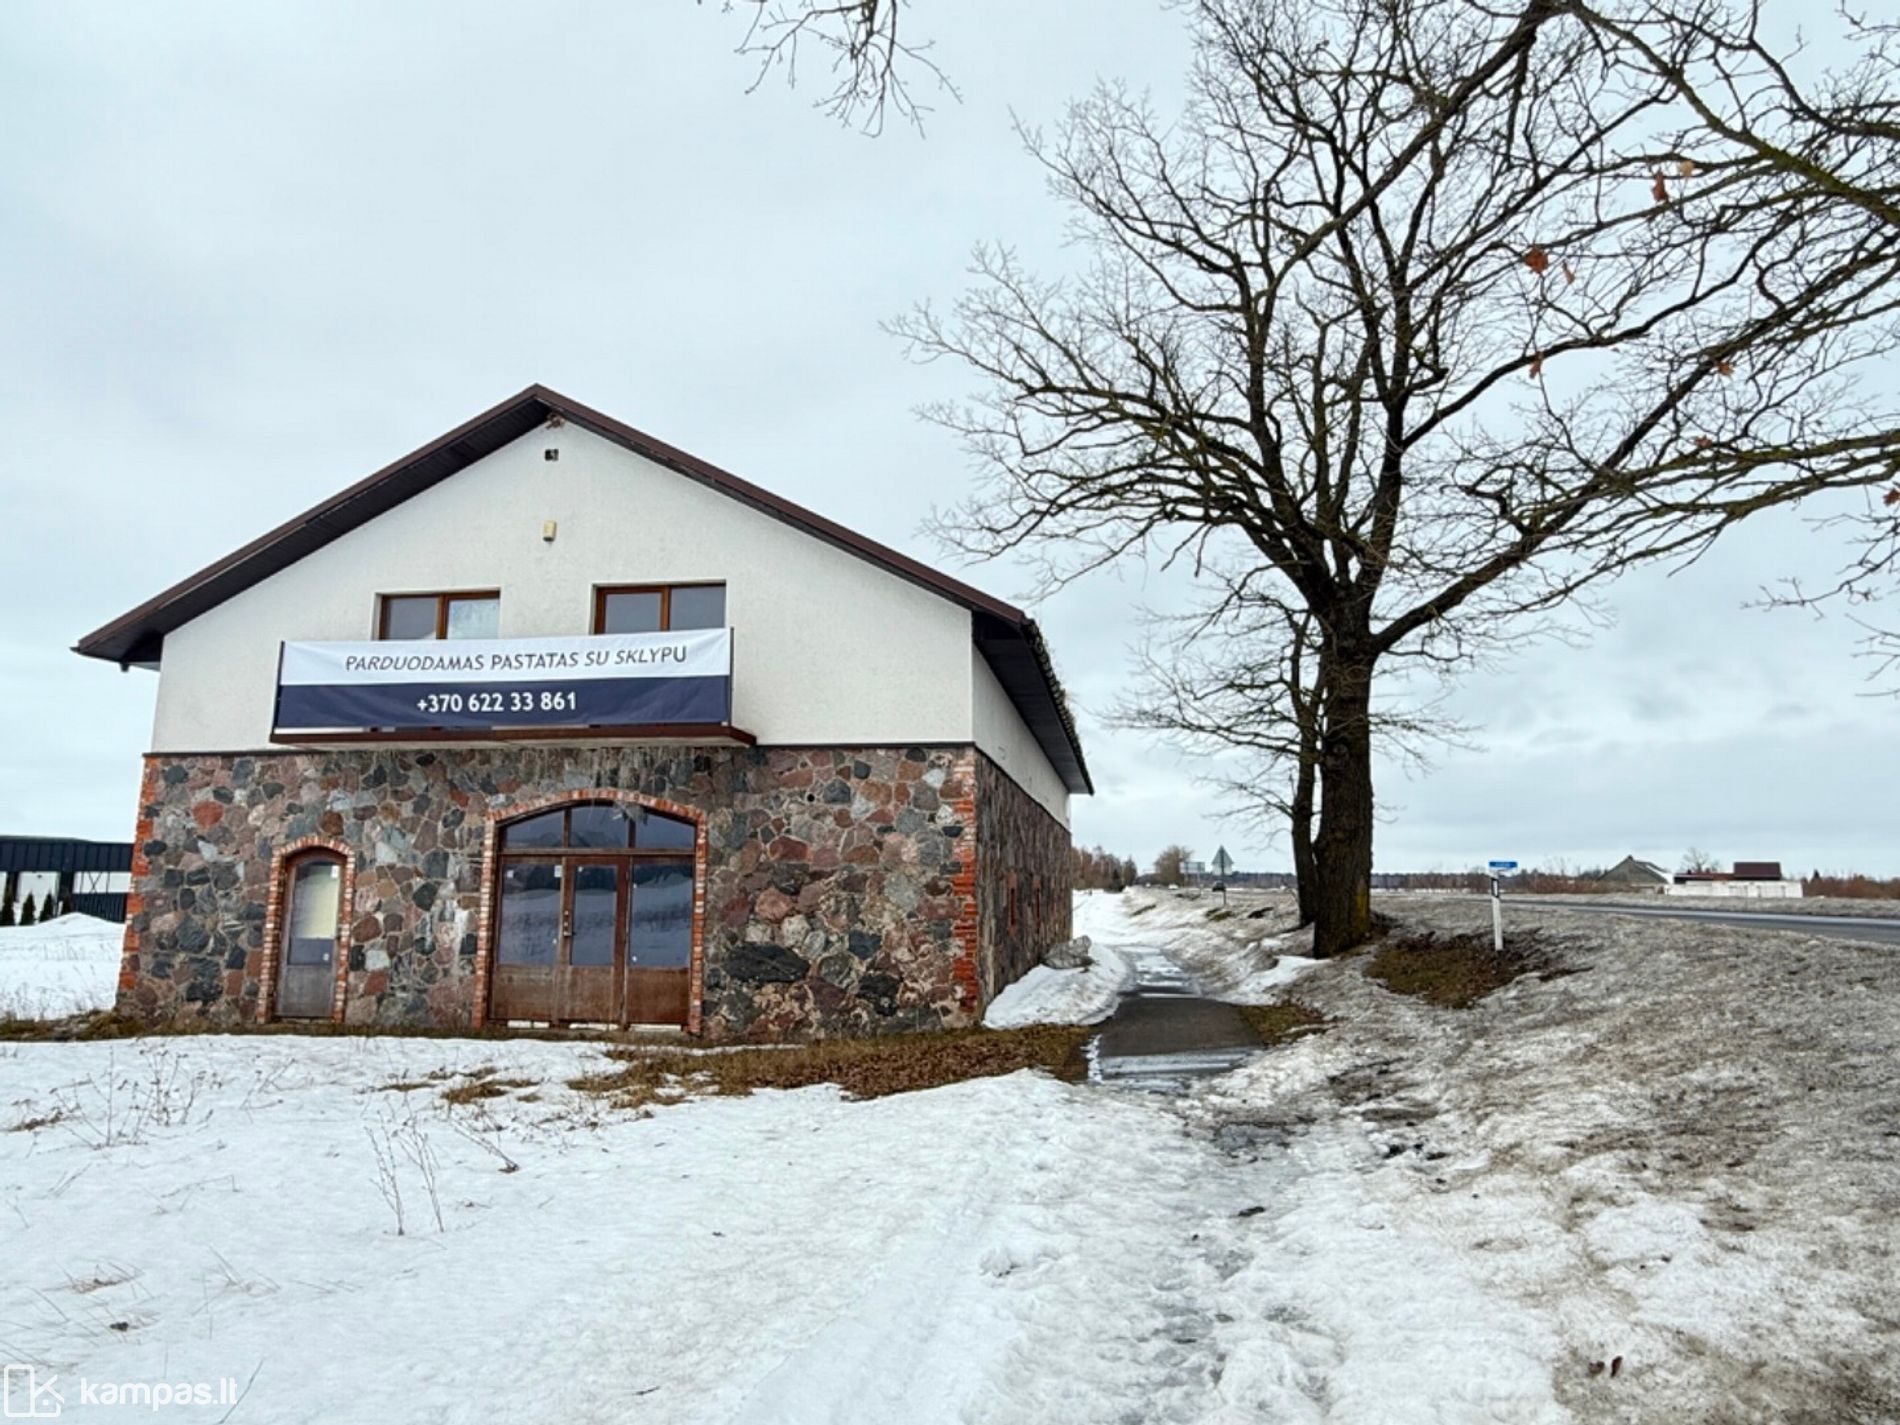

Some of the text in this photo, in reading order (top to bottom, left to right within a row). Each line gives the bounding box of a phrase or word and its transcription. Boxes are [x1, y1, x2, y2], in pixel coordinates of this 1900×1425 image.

[345, 646, 687, 672] PARDUODAMAS PASTATAS SU SKLYPU
[417, 691, 577, 713] +370 622 33 861
